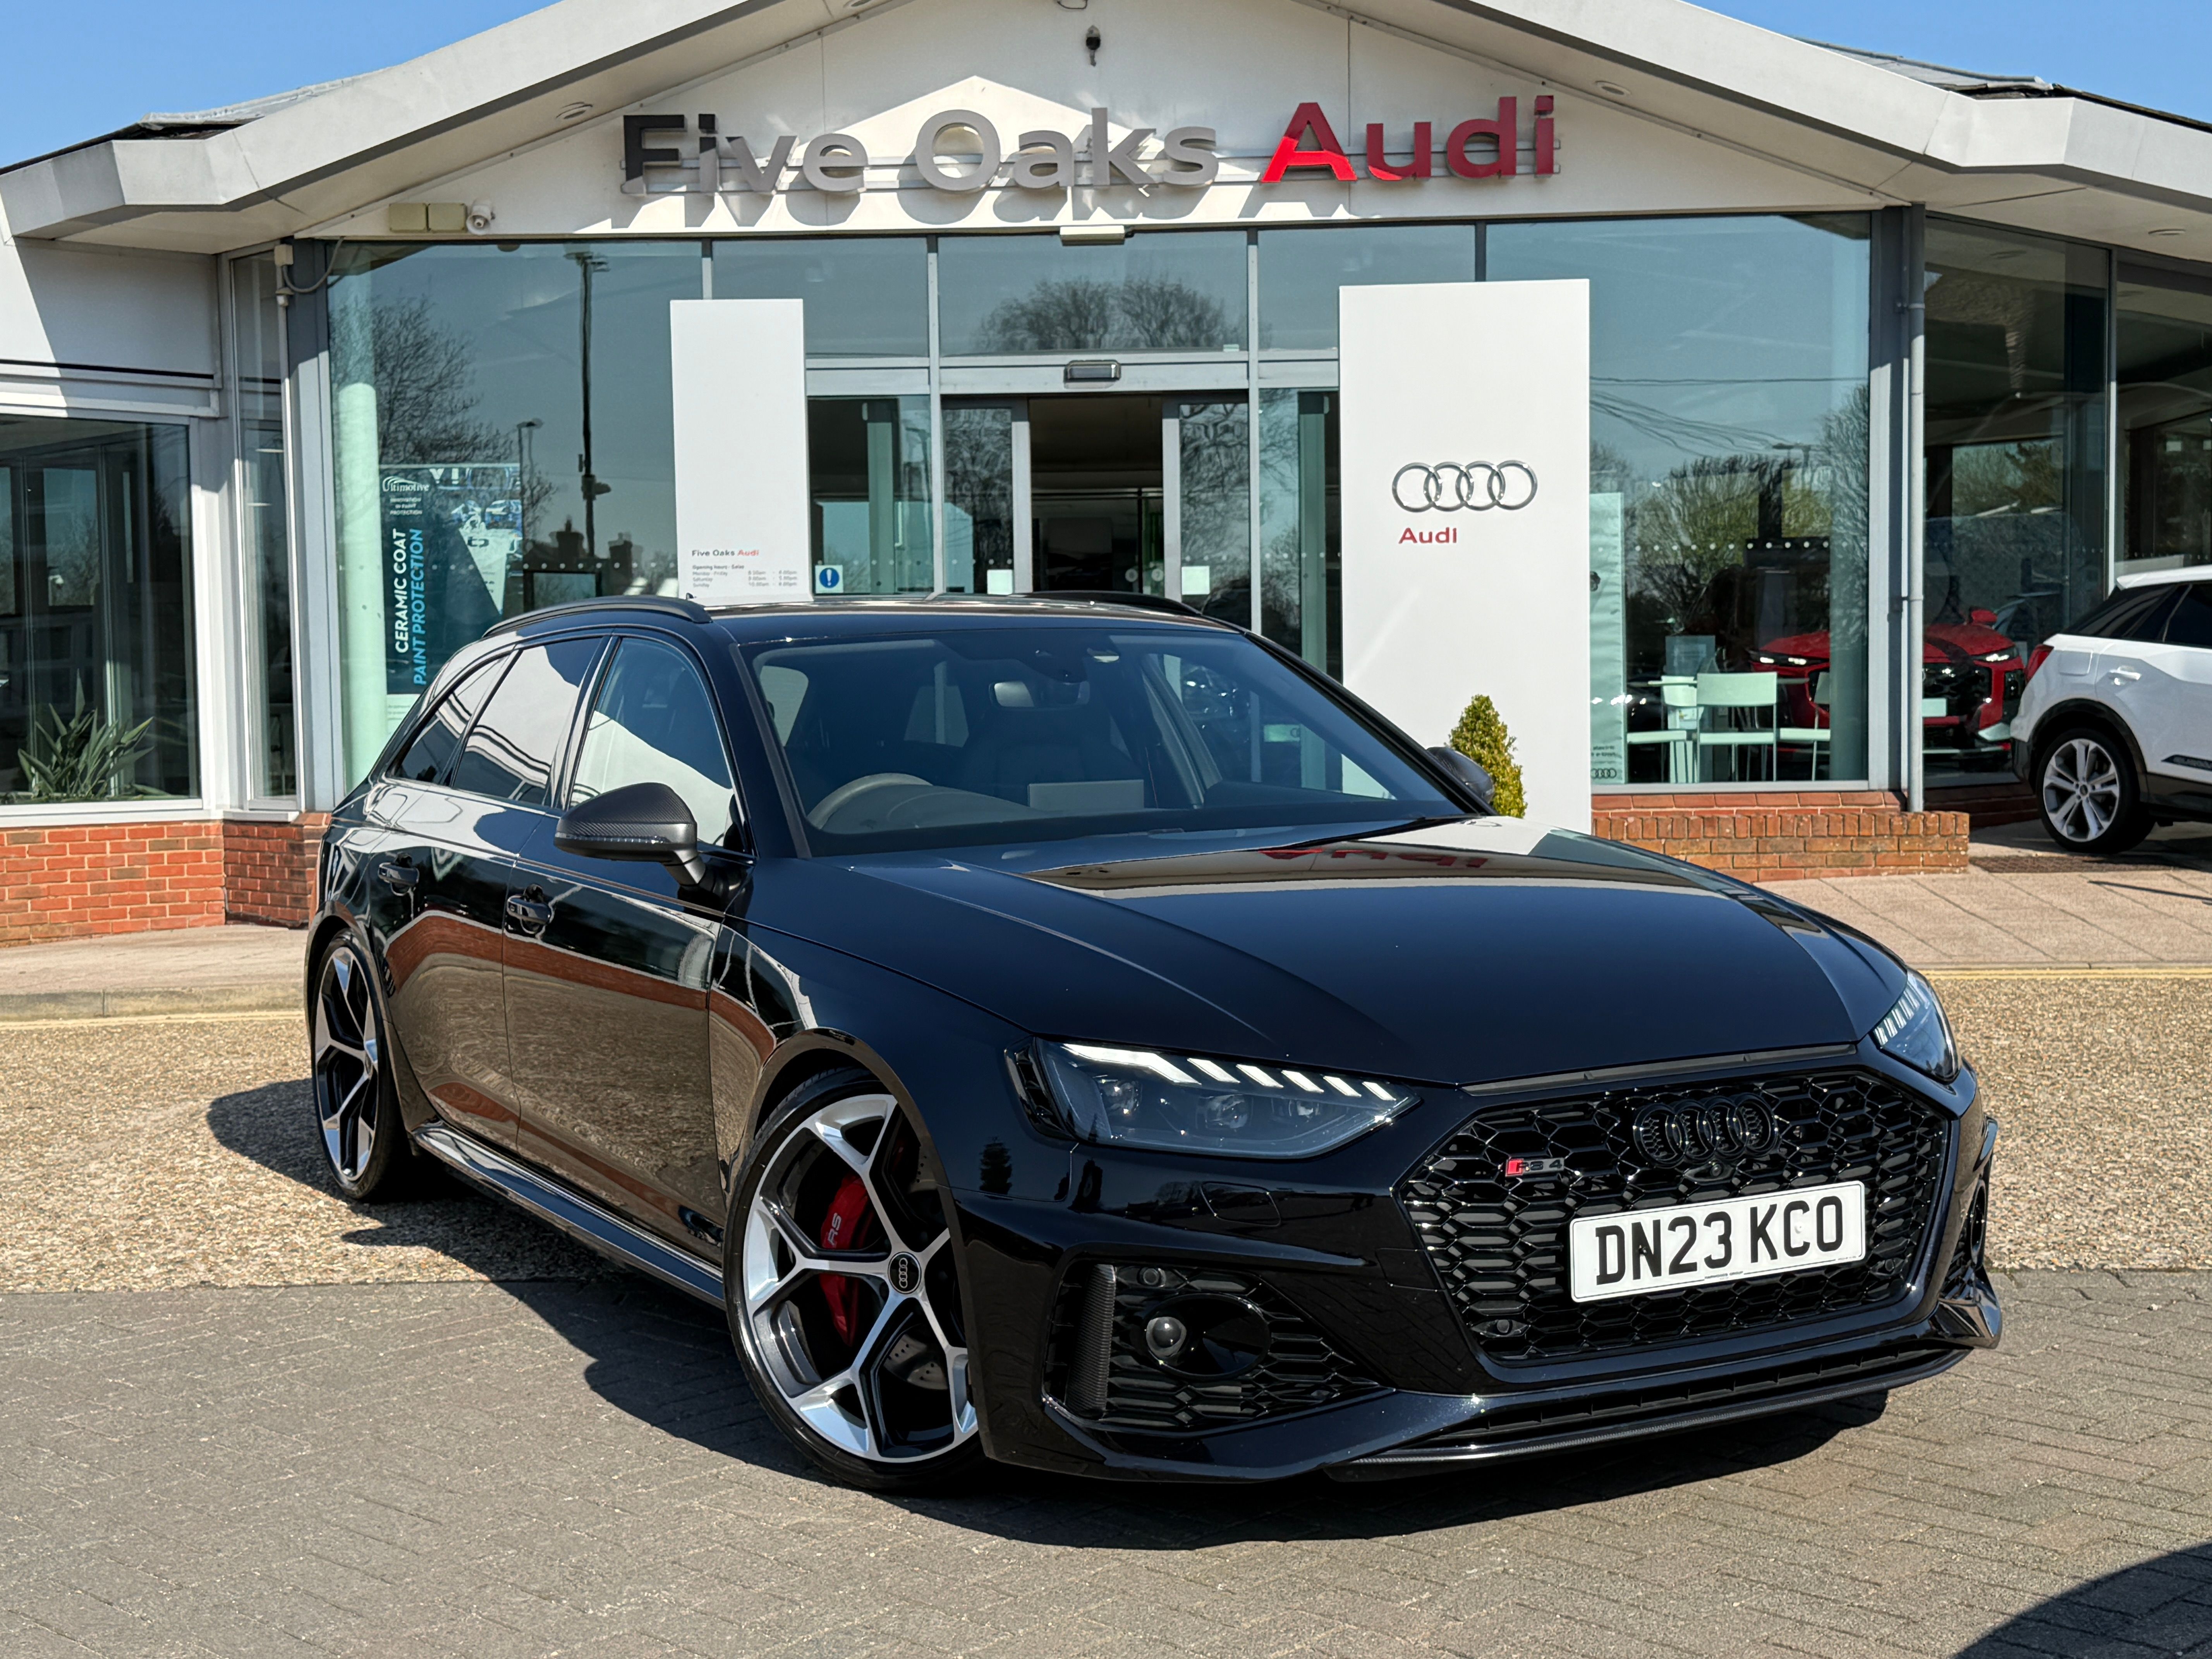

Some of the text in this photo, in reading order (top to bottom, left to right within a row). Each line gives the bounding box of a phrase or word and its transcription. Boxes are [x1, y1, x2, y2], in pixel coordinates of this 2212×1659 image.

[620, 96, 1554, 196] Five Oaks Audi
[1398, 527, 1456, 544] Audi
[393, 528, 409, 653] CERAMIC COAT
[410, 529, 426, 685] PAINT PROTECTION
[828, 1212, 842, 1246] RS
[1595, 1195, 1843, 1285] DN23 KCO
